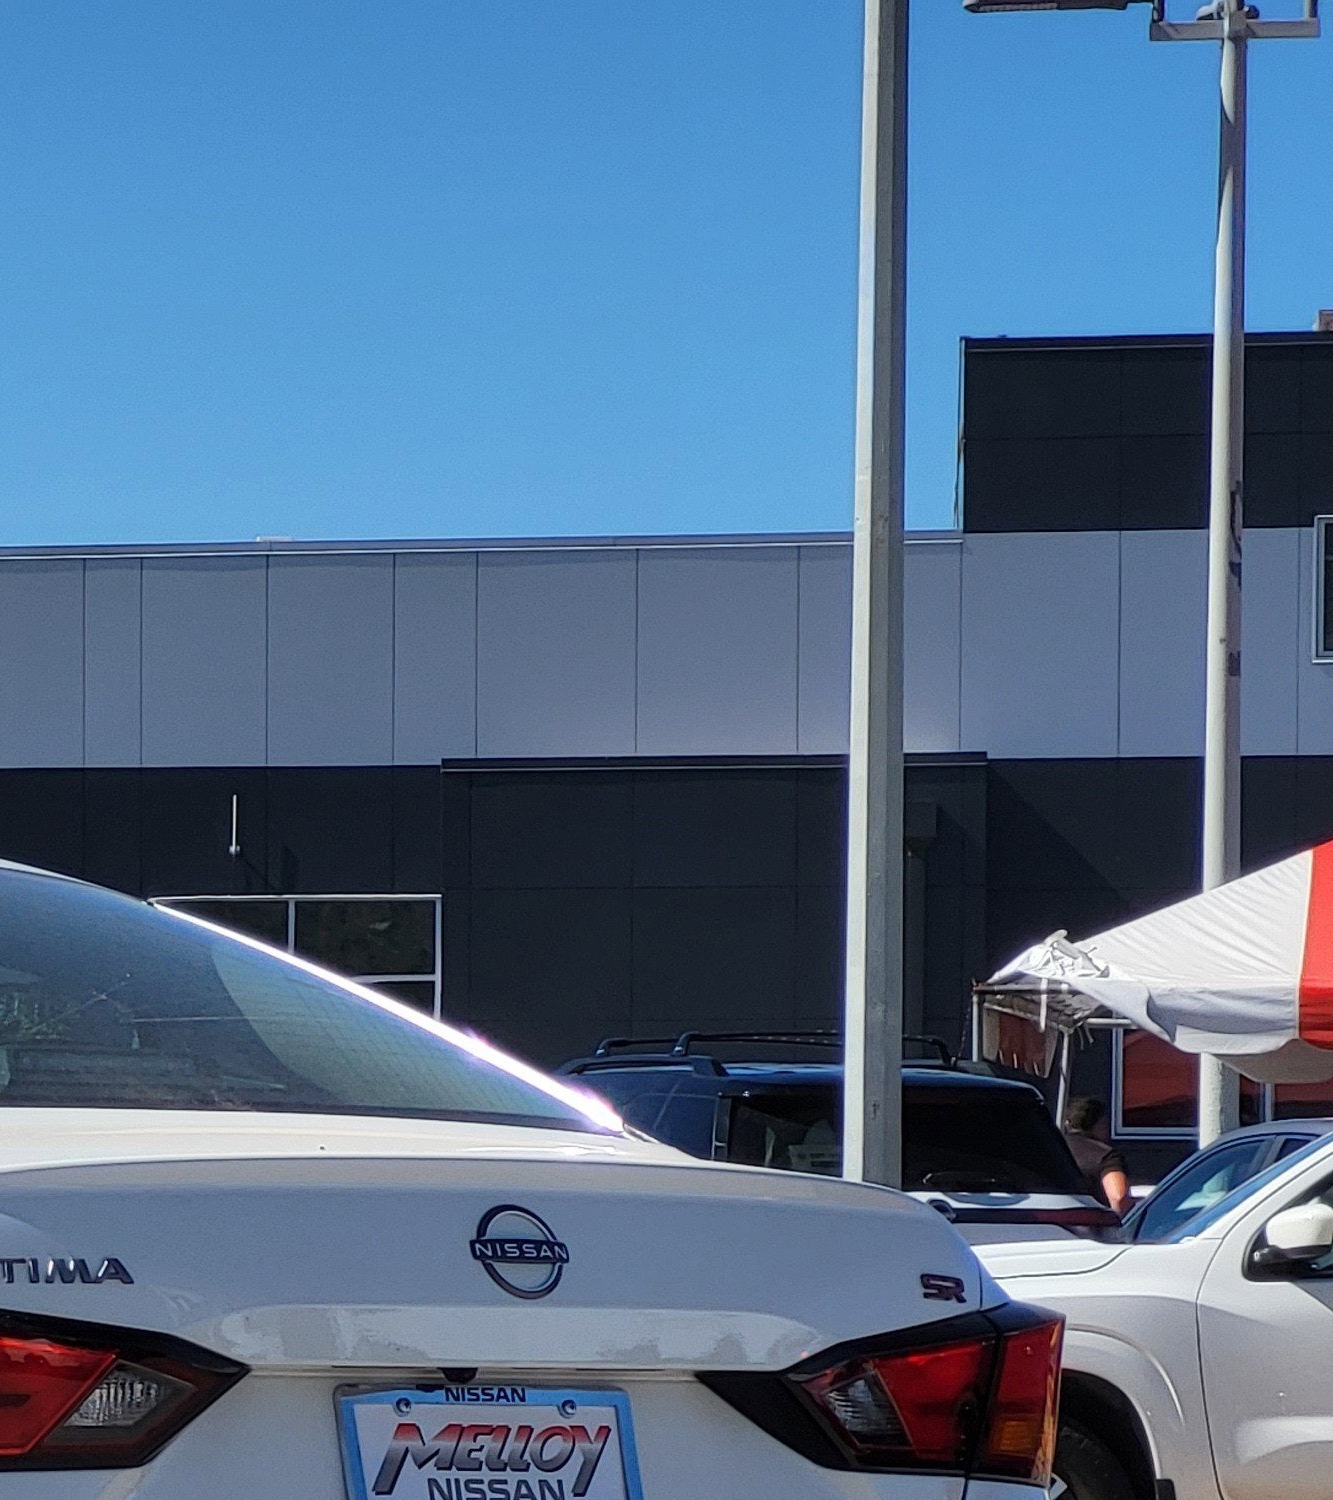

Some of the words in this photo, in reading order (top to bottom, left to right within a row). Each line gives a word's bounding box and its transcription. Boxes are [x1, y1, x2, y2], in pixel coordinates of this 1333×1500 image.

[475, 1242, 568, 1259] NISSAN
[920, 1274, 967, 1303] SR
[444, 1386, 526, 1403] NISSAN
[372, 1422, 612, 1498] MELLOY
